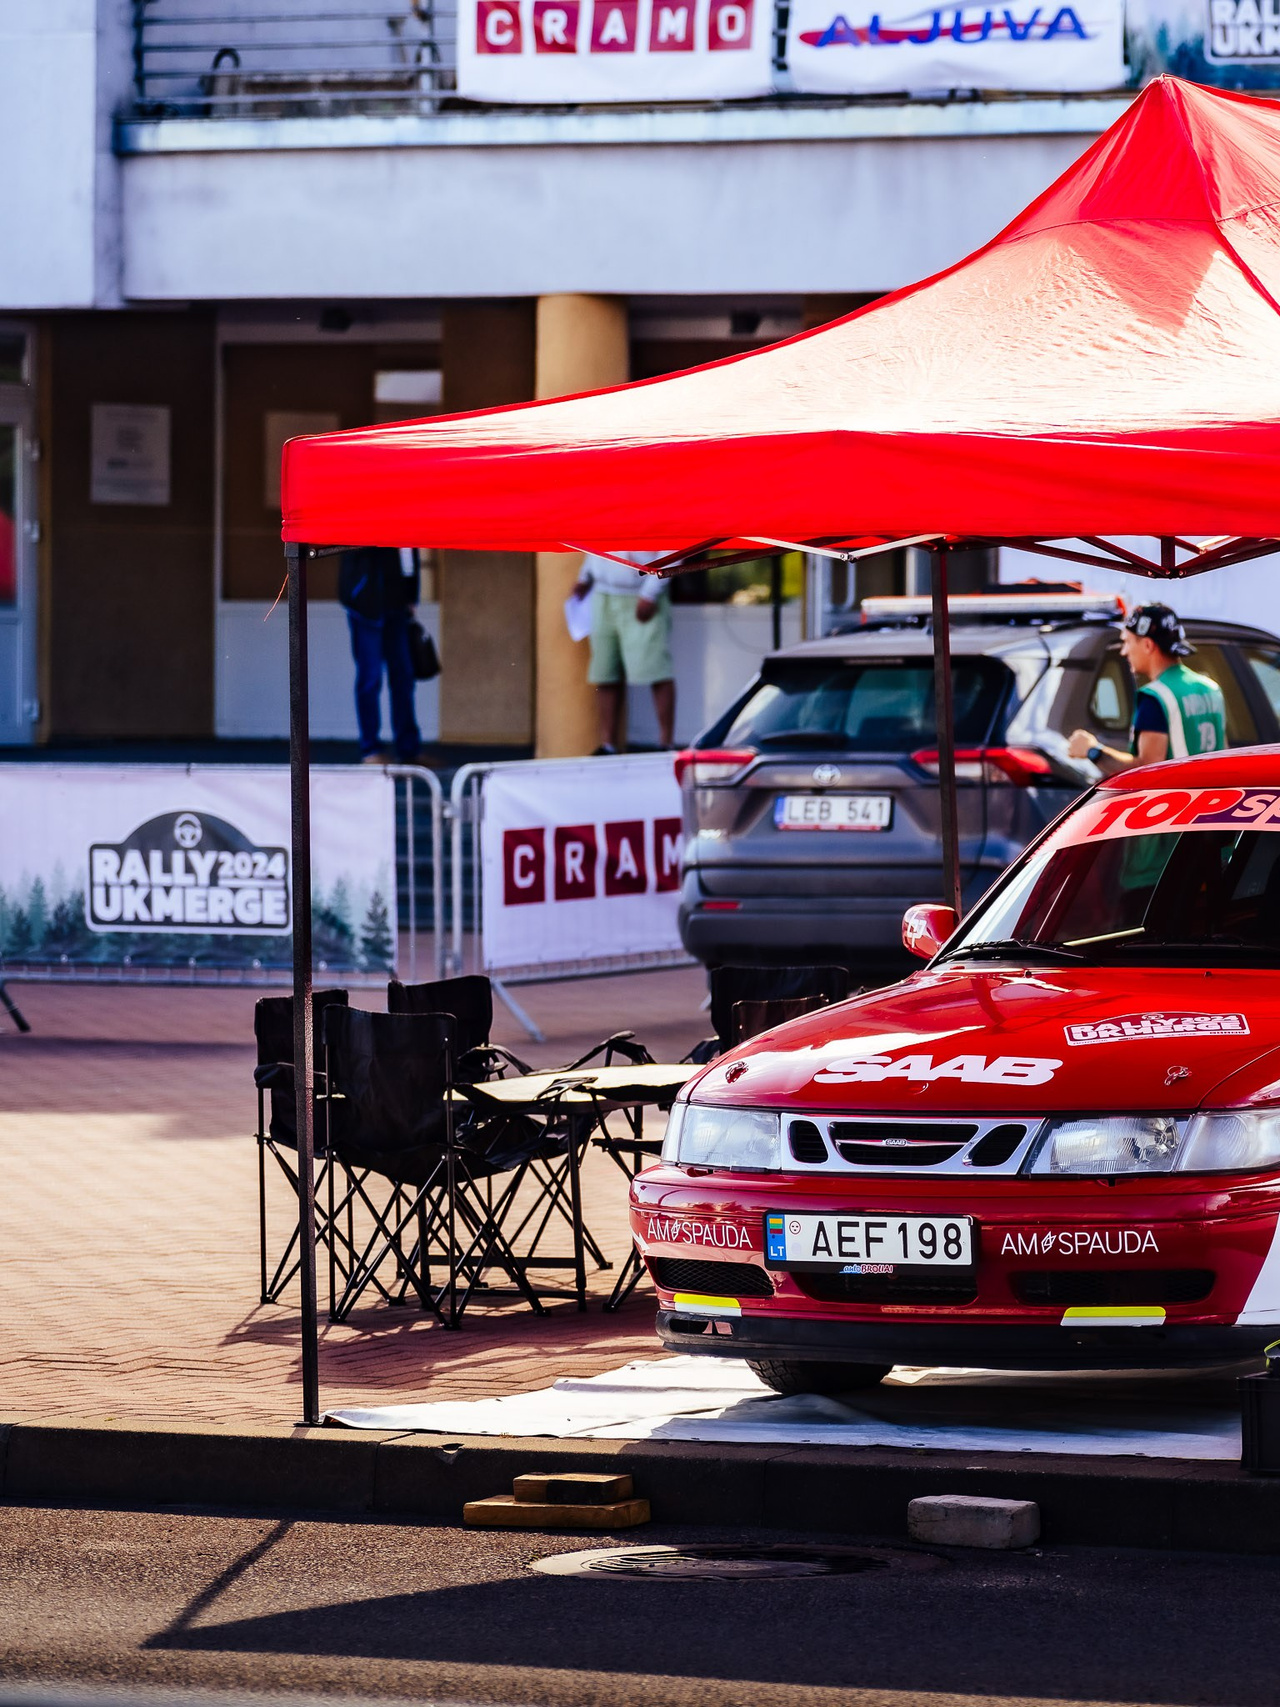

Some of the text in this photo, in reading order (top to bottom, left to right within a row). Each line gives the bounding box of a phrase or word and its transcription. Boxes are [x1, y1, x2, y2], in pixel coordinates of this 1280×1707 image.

[484, 5, 747, 46] CRAMO
[816, 6, 1087, 46] ALJUVA
[788, 800, 884, 821] LEB 541
[92, 848, 286, 886] RALLY 2024
[92, 884, 288, 924] UKMERGE
[1070, 1016, 1180, 1033] RALLY
[1072, 1020, 1243, 1041] UKMERGE
[813, 1054, 1064, 1086] SAAB
[681, 1221, 754, 1249] SPAUDA
[1058, 1230, 1160, 1255] SPAUDA
[770, 1245, 785, 1257] LT
